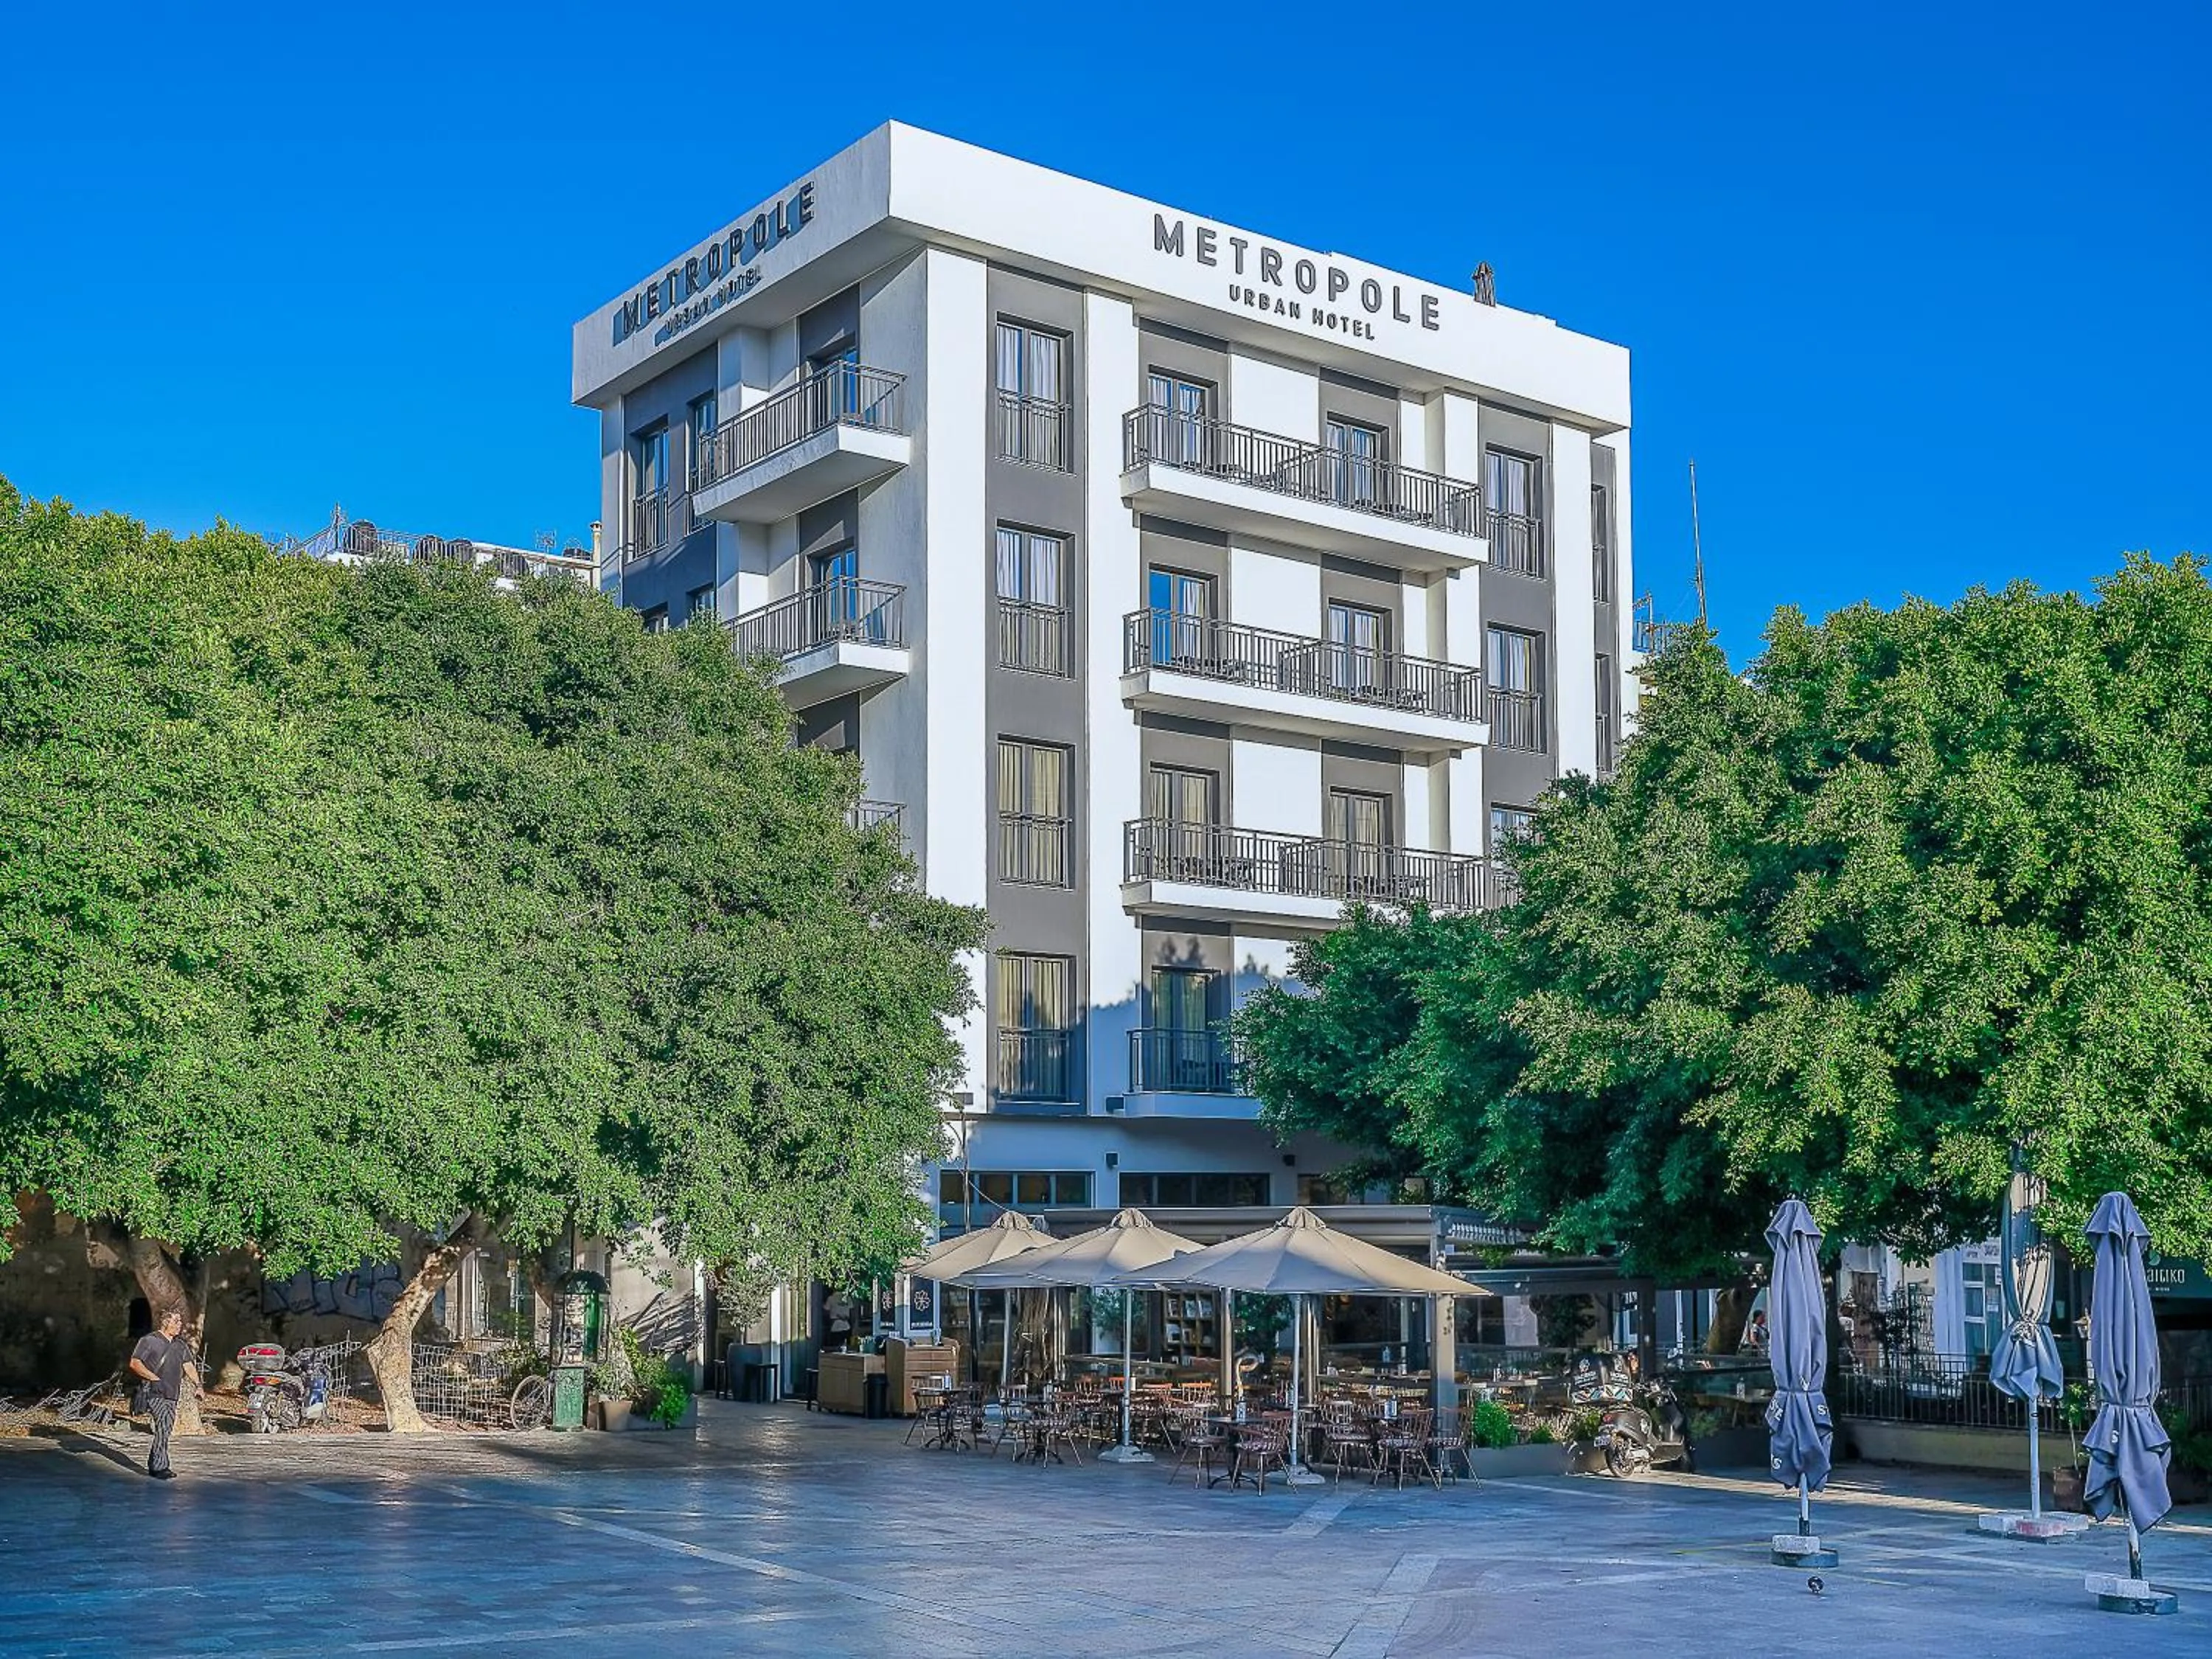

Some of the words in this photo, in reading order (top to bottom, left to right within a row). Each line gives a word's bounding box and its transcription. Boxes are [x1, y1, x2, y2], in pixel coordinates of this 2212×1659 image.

[623, 181, 814, 335] METROPOLE
[1154, 213, 1440, 331] METROPOLE
[1229, 284, 1301, 320] URBAN
[1312, 307, 1375, 341] HOTEL
